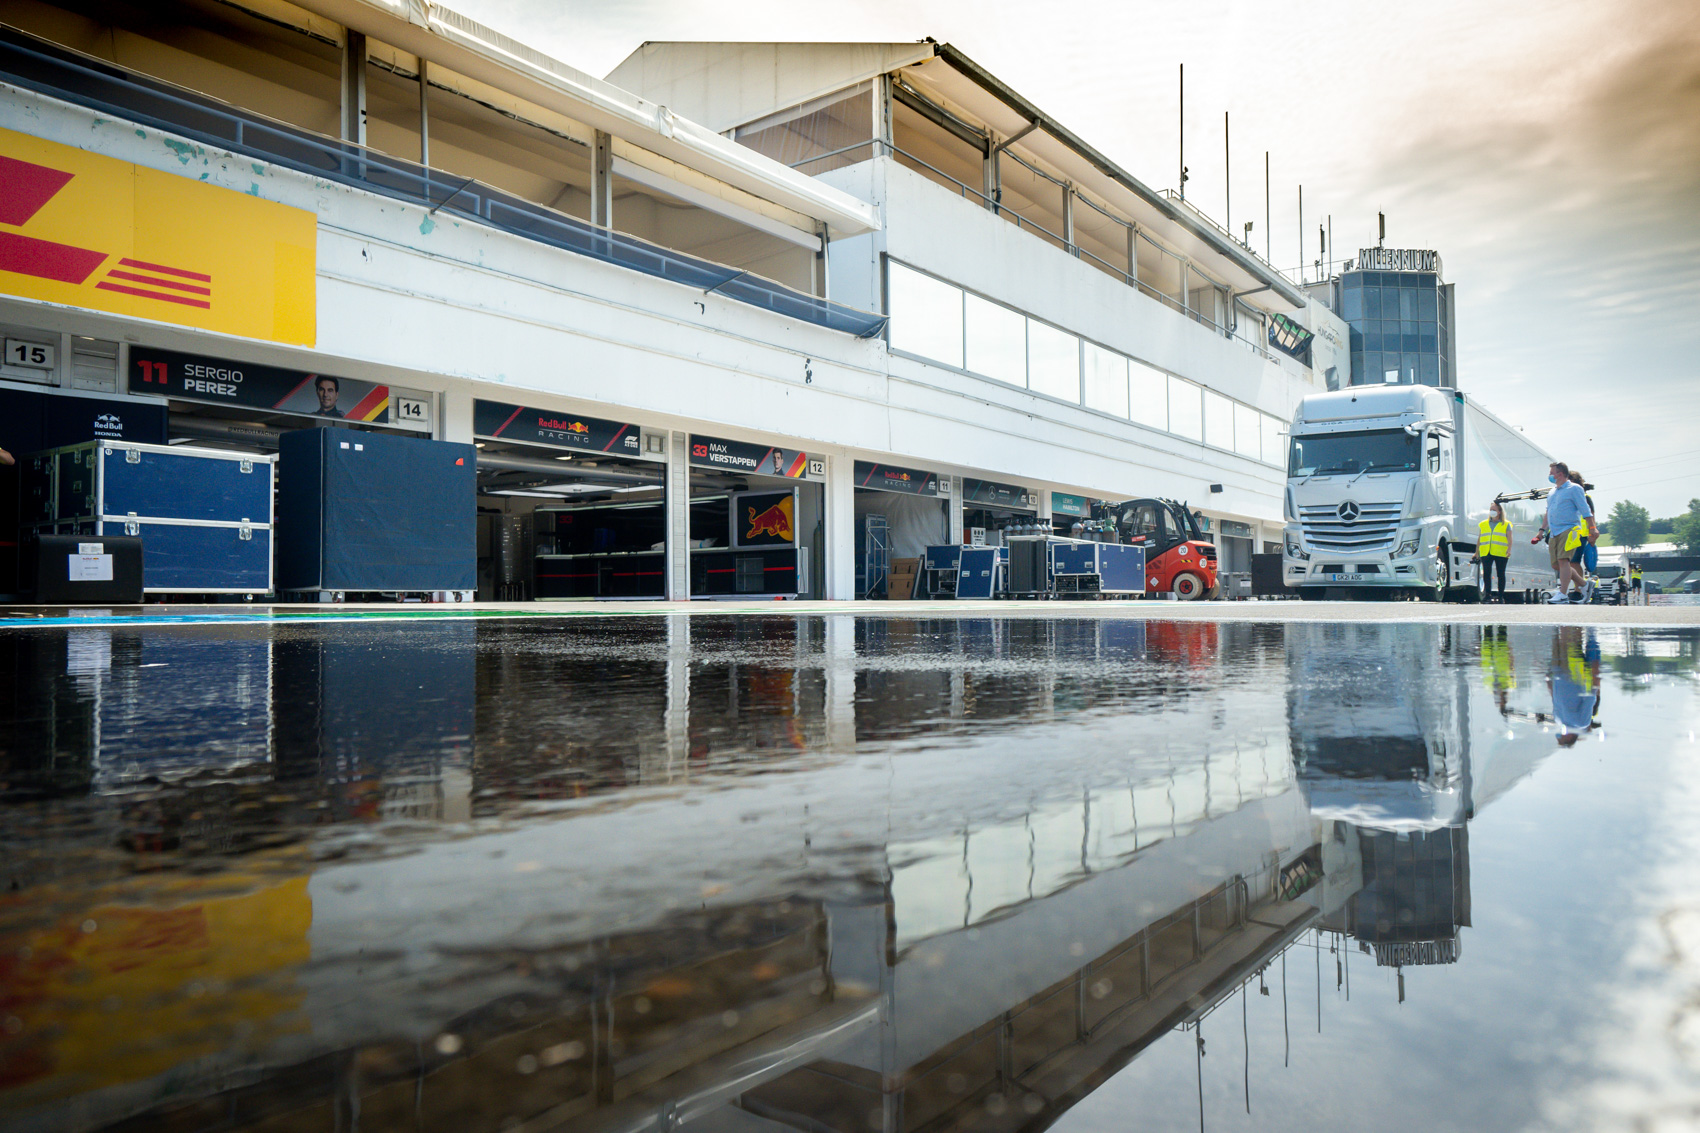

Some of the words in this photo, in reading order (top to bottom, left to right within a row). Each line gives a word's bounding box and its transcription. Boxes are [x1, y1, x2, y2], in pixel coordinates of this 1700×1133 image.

[1359, 248, 1434, 271] MILLENNIUM
[15, 345, 46, 364] 15
[137, 360, 168, 384] 11
[184, 364, 244, 383] SERGIO
[184, 378, 238, 397] PEREZ
[403, 402, 421, 416] 14
[94, 421, 109, 429] Red
[109, 422, 123, 431] Bull
[538, 417, 553, 430] Red
[553, 419, 567, 430] Bull
[538, 432, 590, 444] RACING
[693, 444, 708, 457] 33
[709, 443, 728, 453] MAX
[709, 453, 757, 467] VERSTAPPEN
[813, 463, 823, 473] 12
[884, 481, 911, 489] RACING
[942, 482, 949, 491] 11
[1180, 546, 1187, 554] 20
